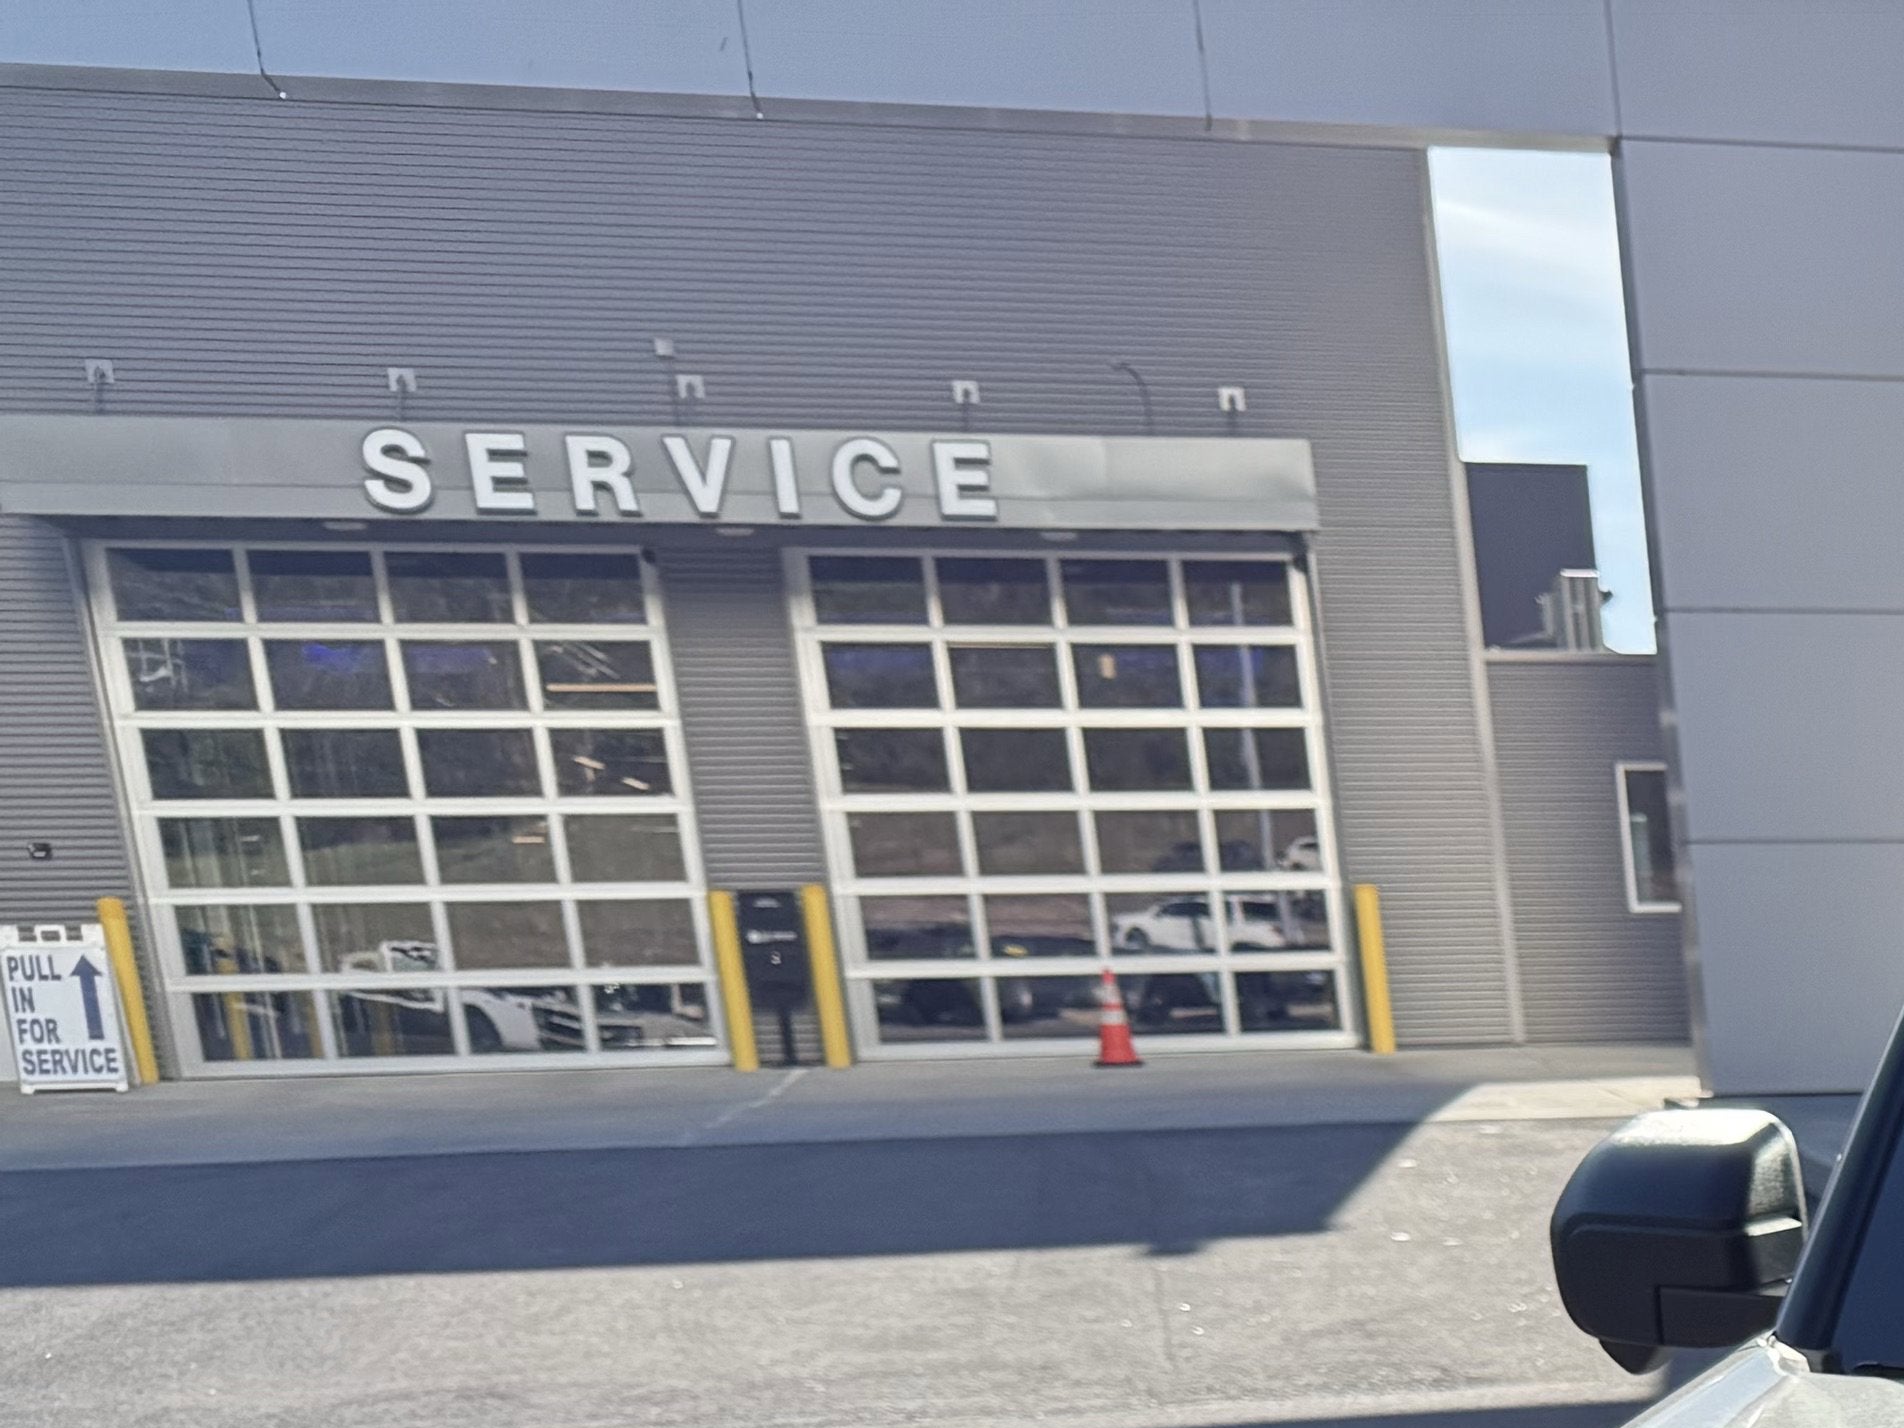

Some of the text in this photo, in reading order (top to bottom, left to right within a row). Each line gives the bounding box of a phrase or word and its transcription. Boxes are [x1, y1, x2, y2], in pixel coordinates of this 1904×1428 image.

[361, 429, 998, 521] SERVICE
[7, 954, 62, 981] PULL
[12, 986, 35, 1013] IN
[16, 1018, 61, 1044] FOR
[22, 1048, 119, 1075] SERVICE
